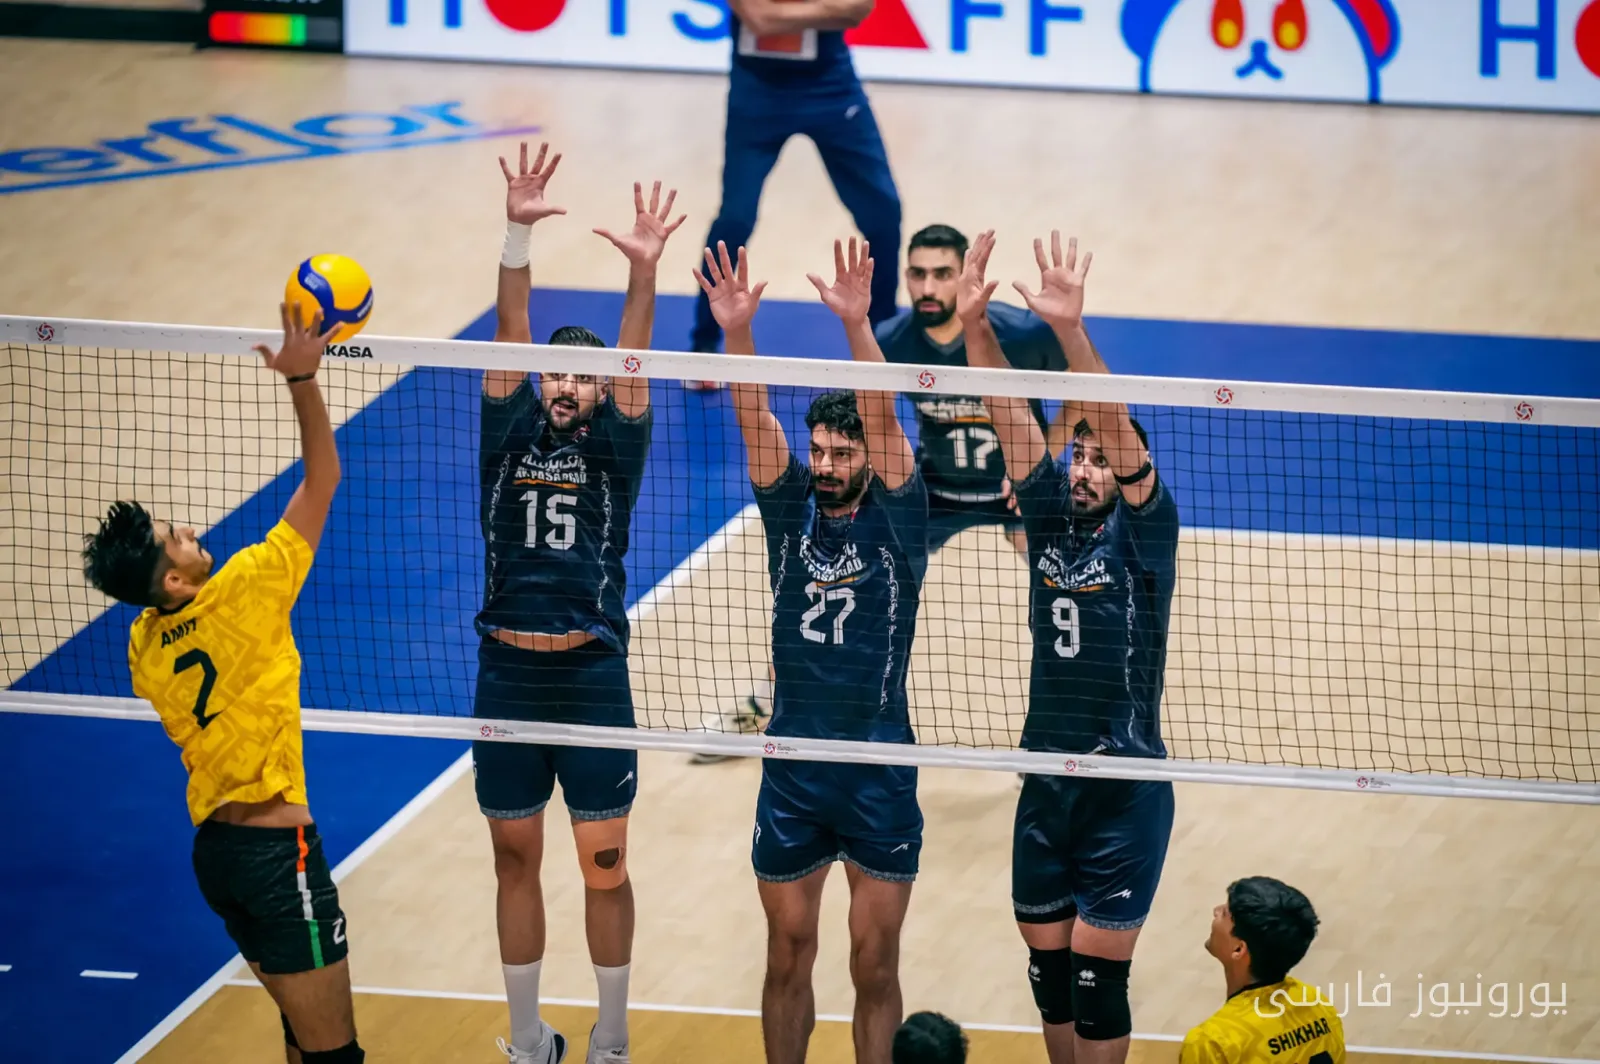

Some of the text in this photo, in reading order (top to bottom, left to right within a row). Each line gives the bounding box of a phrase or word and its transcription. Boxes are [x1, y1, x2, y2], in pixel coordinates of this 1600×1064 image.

[322, 344, 373, 359] KASA
[946, 426, 999, 470] 17
[518, 490, 578, 550] 15
[161, 617, 197, 648] AMIT
[799, 581, 857, 645] 27
[1051, 597, 1081, 658] 9
[173, 648, 225, 730] 2
[332, 917, 345, 945] 2
[1267, 1017, 1331, 1056] SHIKHAR
